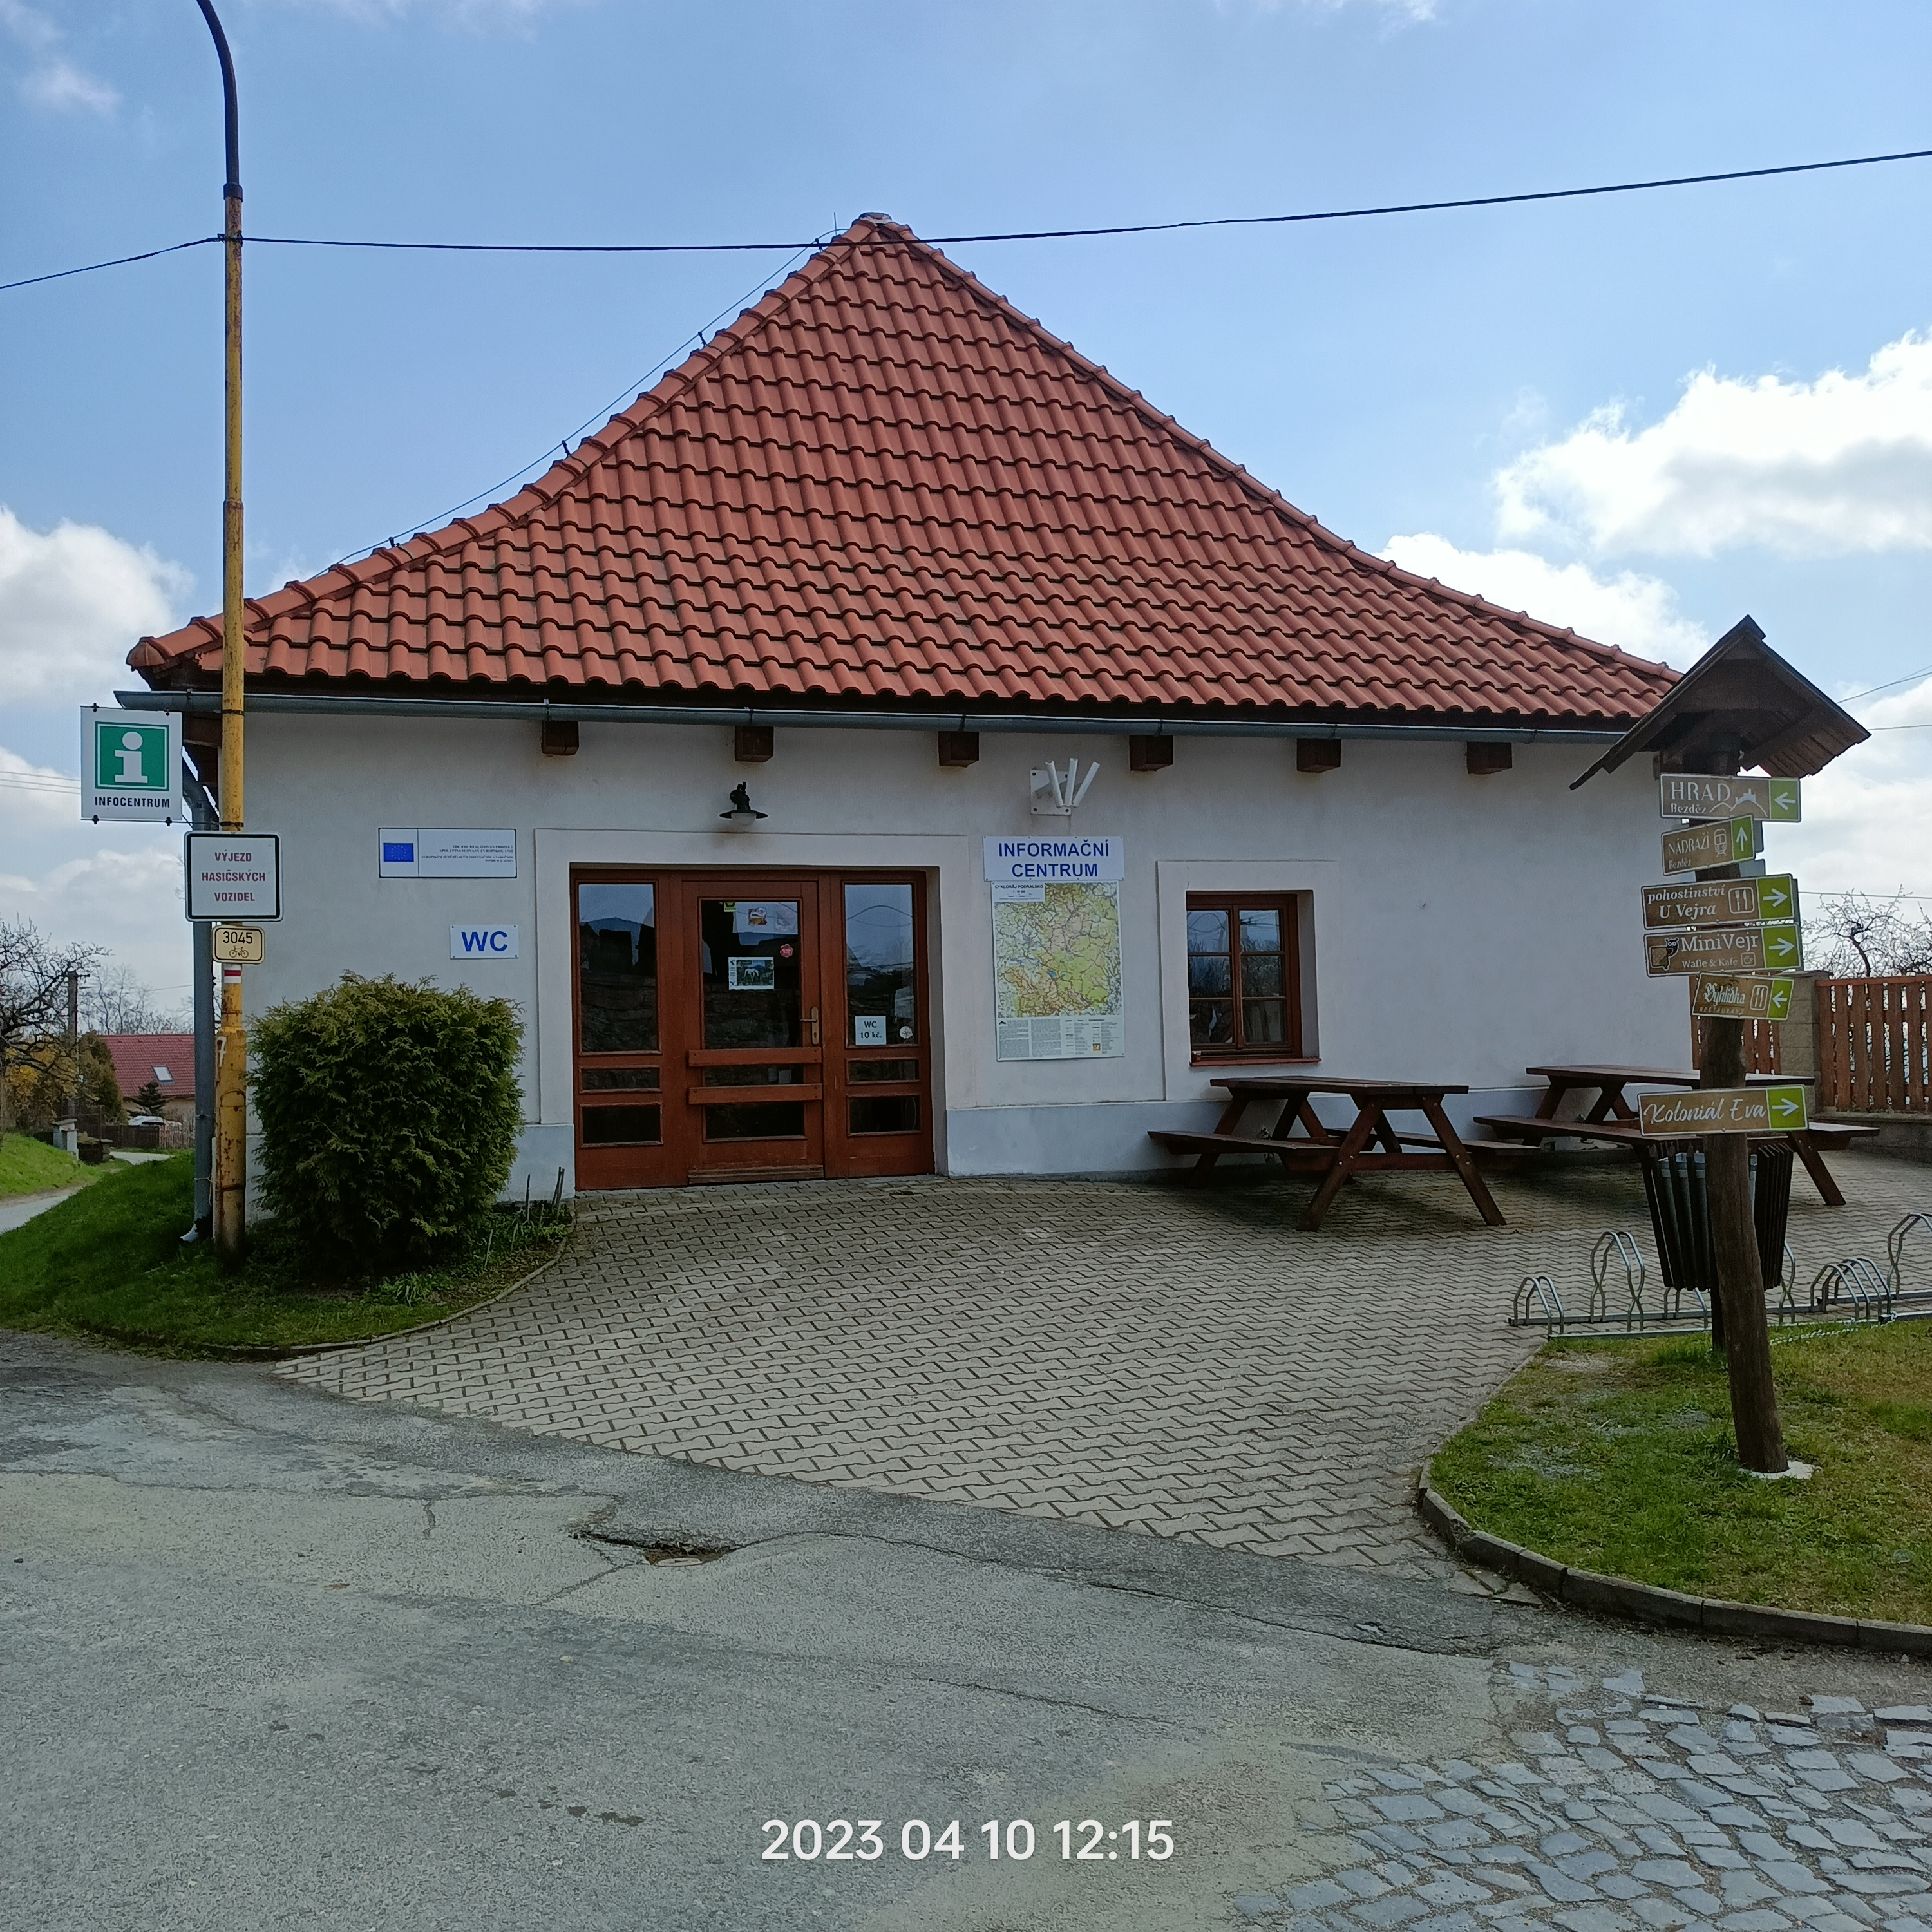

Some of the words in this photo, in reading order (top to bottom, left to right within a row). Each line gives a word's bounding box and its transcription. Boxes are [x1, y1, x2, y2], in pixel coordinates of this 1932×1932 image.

[1670, 781, 1731, 802] HRAD
[94, 796, 171, 808] INFOCENTRUM
[1671, 803, 1707, 814] Bezděz
[998, 839, 1110, 857] INFORMAČNÍ
[1668, 831, 1709, 855] NÁDRAŽÍ
[214, 849, 252, 862] VÝJEZD
[1011, 863, 1099, 878] CENTRUM
[1669, 858, 1692, 870] Bezděz
[202, 869, 266, 882] HASIČSKÝCH
[214, 892, 256, 902] VOZIDEL
[1647, 884, 1726, 905] pohostinství
[1659, 905, 1671, 919] U
[1676, 903, 1717, 920] Vejra
[222, 931, 253, 944] 3045
[461, 931, 508, 952] WC
[1680, 931, 1759, 952] MiniVejr
[1681, 959, 1707, 968] Wafle
[1718, 957, 1738, 967] Kafe
[1643, 1097, 1725, 1124] Koloniál
[1729, 1098, 1766, 1121] Eva
